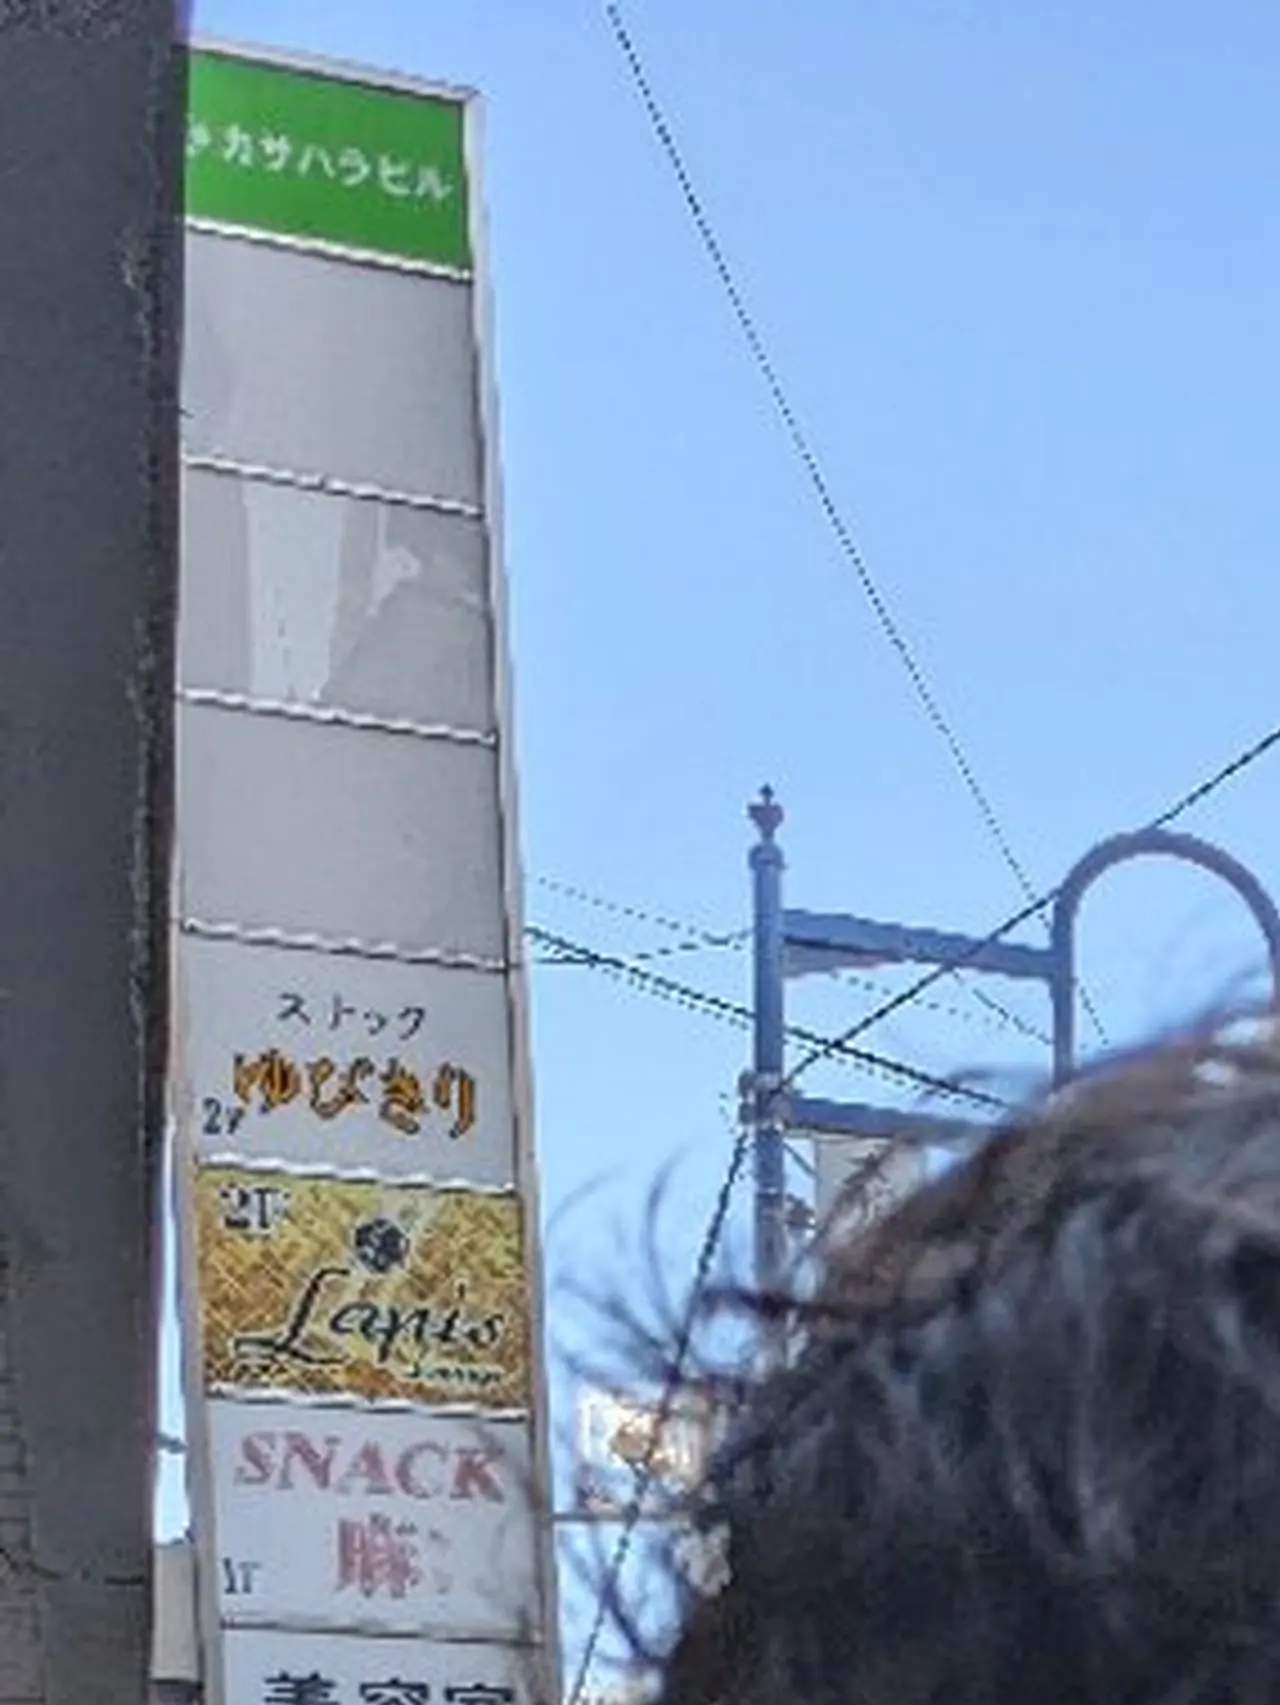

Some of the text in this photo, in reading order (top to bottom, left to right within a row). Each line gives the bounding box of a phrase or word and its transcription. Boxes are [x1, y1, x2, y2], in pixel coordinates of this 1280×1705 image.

[234, 1048, 475, 1138] ゆびきり
[234, 1431, 507, 1502] SNACK
